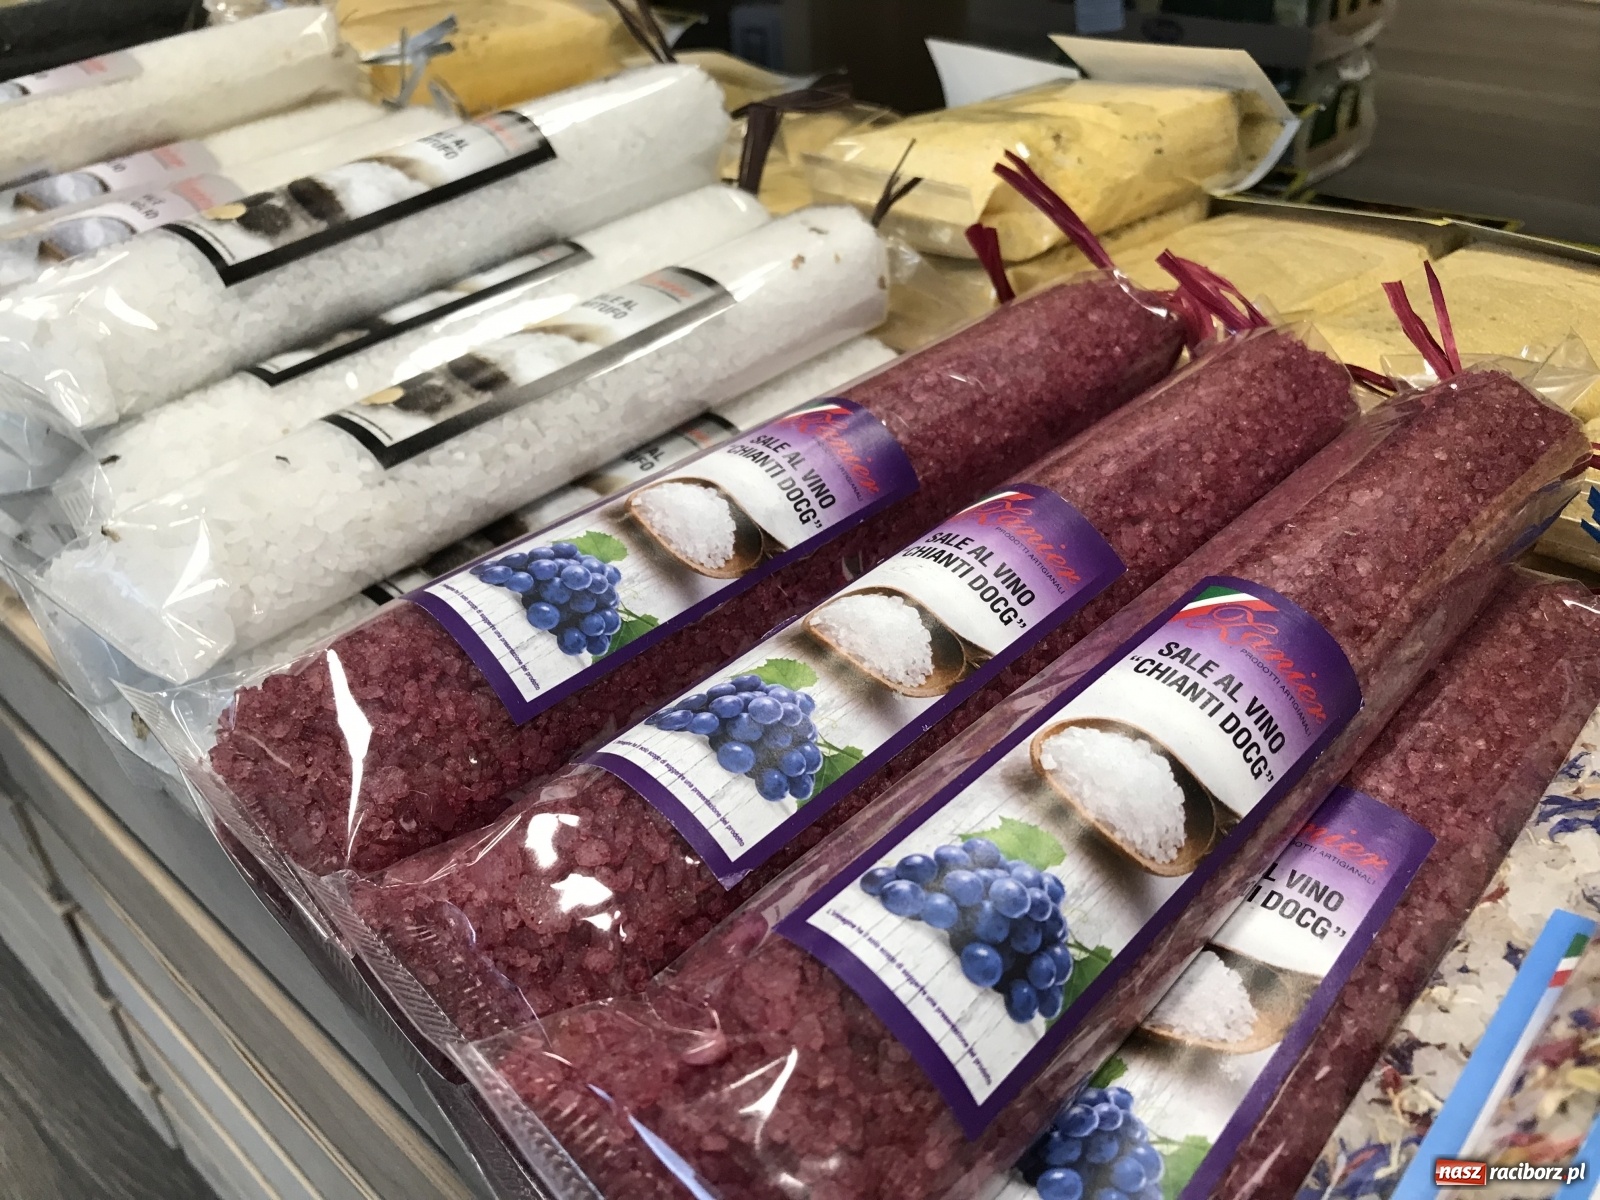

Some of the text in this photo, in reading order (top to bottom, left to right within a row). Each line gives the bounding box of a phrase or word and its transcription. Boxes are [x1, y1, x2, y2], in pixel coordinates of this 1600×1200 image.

[750, 434, 837, 510] SALE AL VINO
[925, 531, 1036, 607] SALE AL VINO
[995, 526, 1067, 595] PRODOTTI ARTIGIANALI
[1129, 655, 1275, 783] “CHIANTI DOCG”
[1157, 641, 1286, 755] SALE AL VINO
[1240, 648, 1312, 737] PRODOTTI ARTIGIANALI
[1285, 868, 1345, 912] VINO
[1318, 849, 1377, 886] ARTIGIANALI
[1260, 889, 1347, 941] DOCG”
